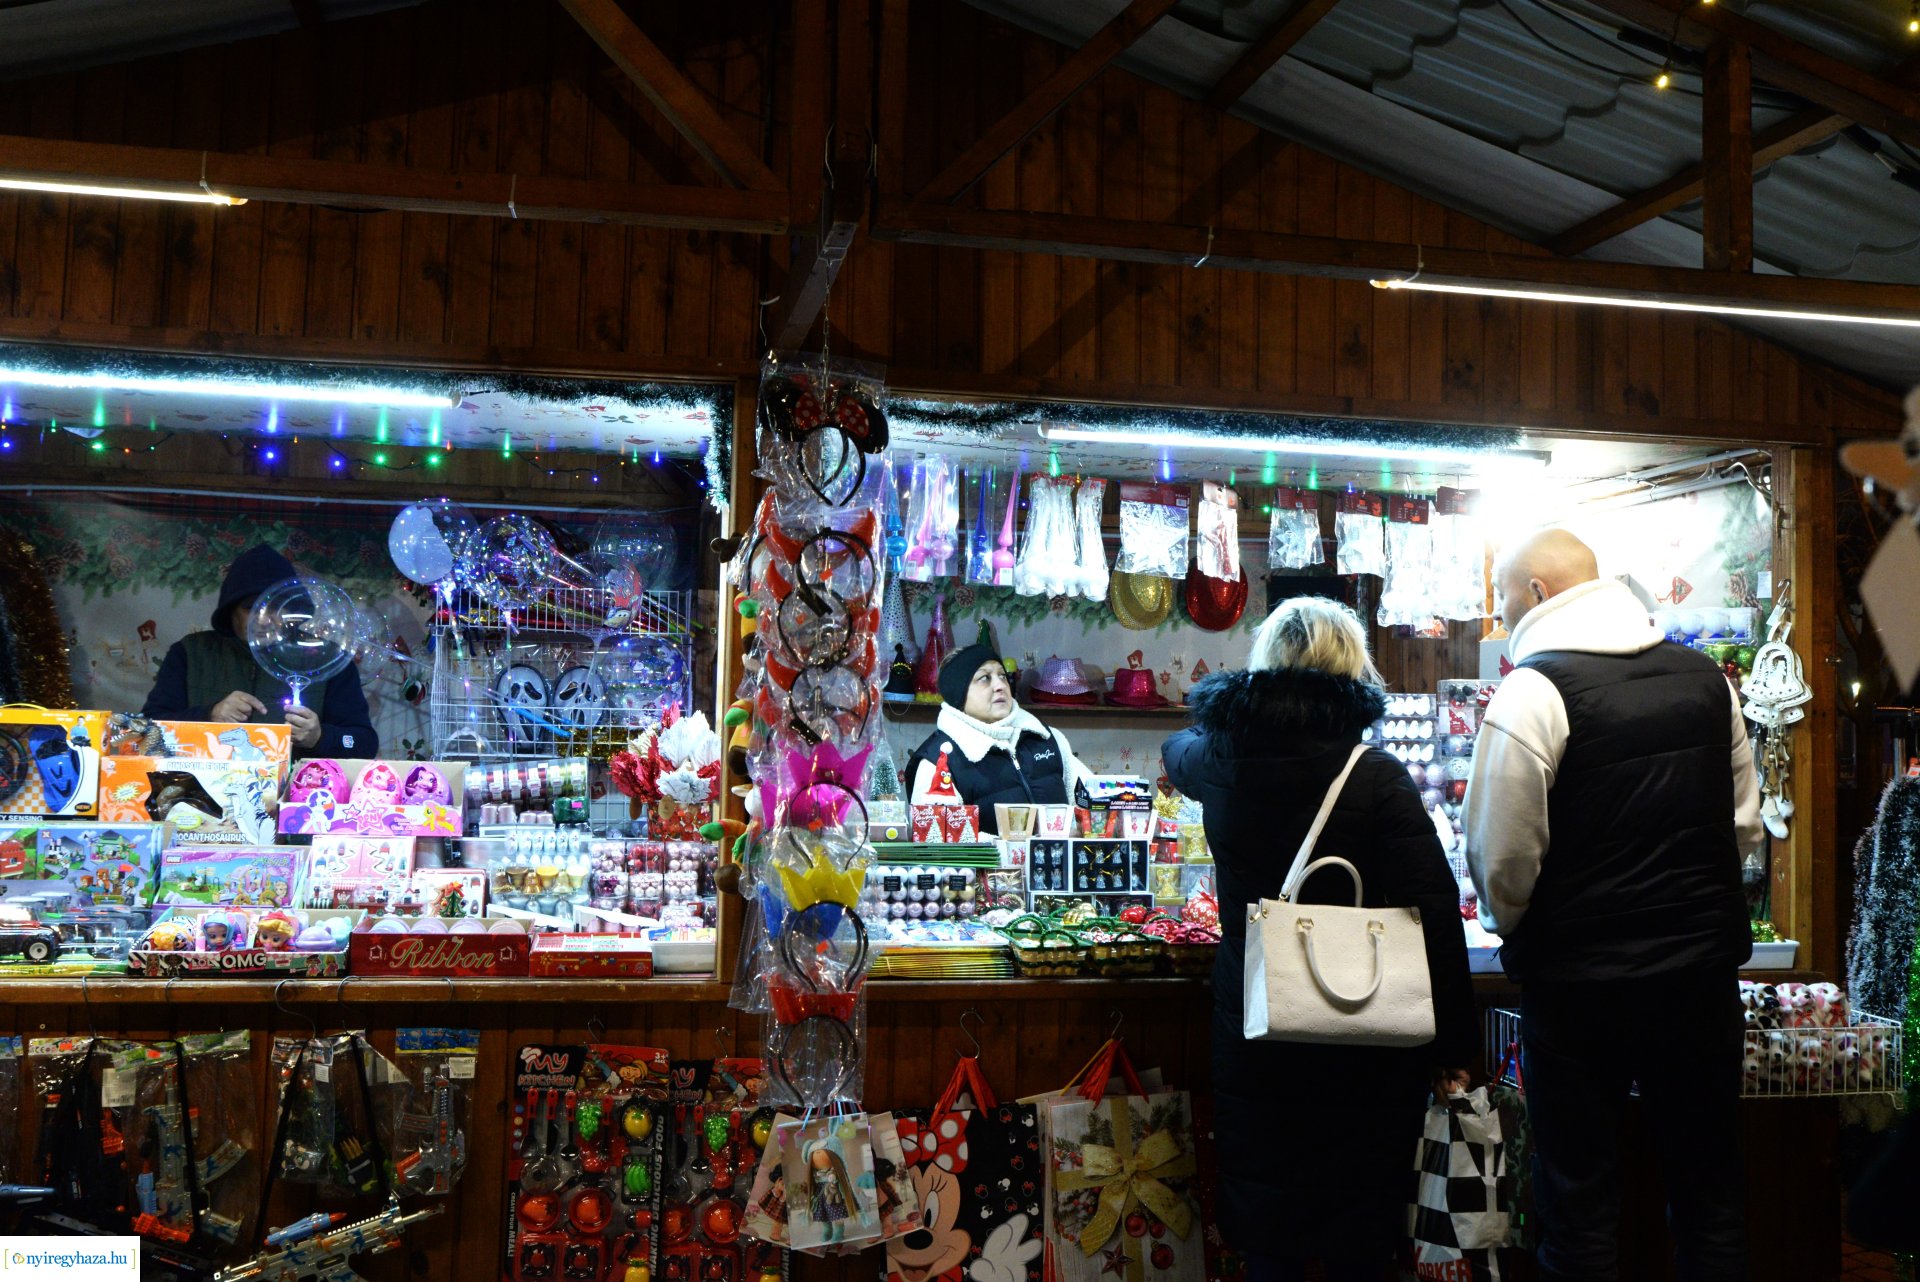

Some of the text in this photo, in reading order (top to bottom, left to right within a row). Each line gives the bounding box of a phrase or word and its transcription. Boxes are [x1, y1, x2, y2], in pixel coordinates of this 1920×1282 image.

[389, 936, 496, 968] Ribbon
[527, 1051, 570, 1074] MY
[516, 1073, 577, 1087] KITCHEN
[649, 1115, 665, 1277] MAKING DELICIOUS FOOD
